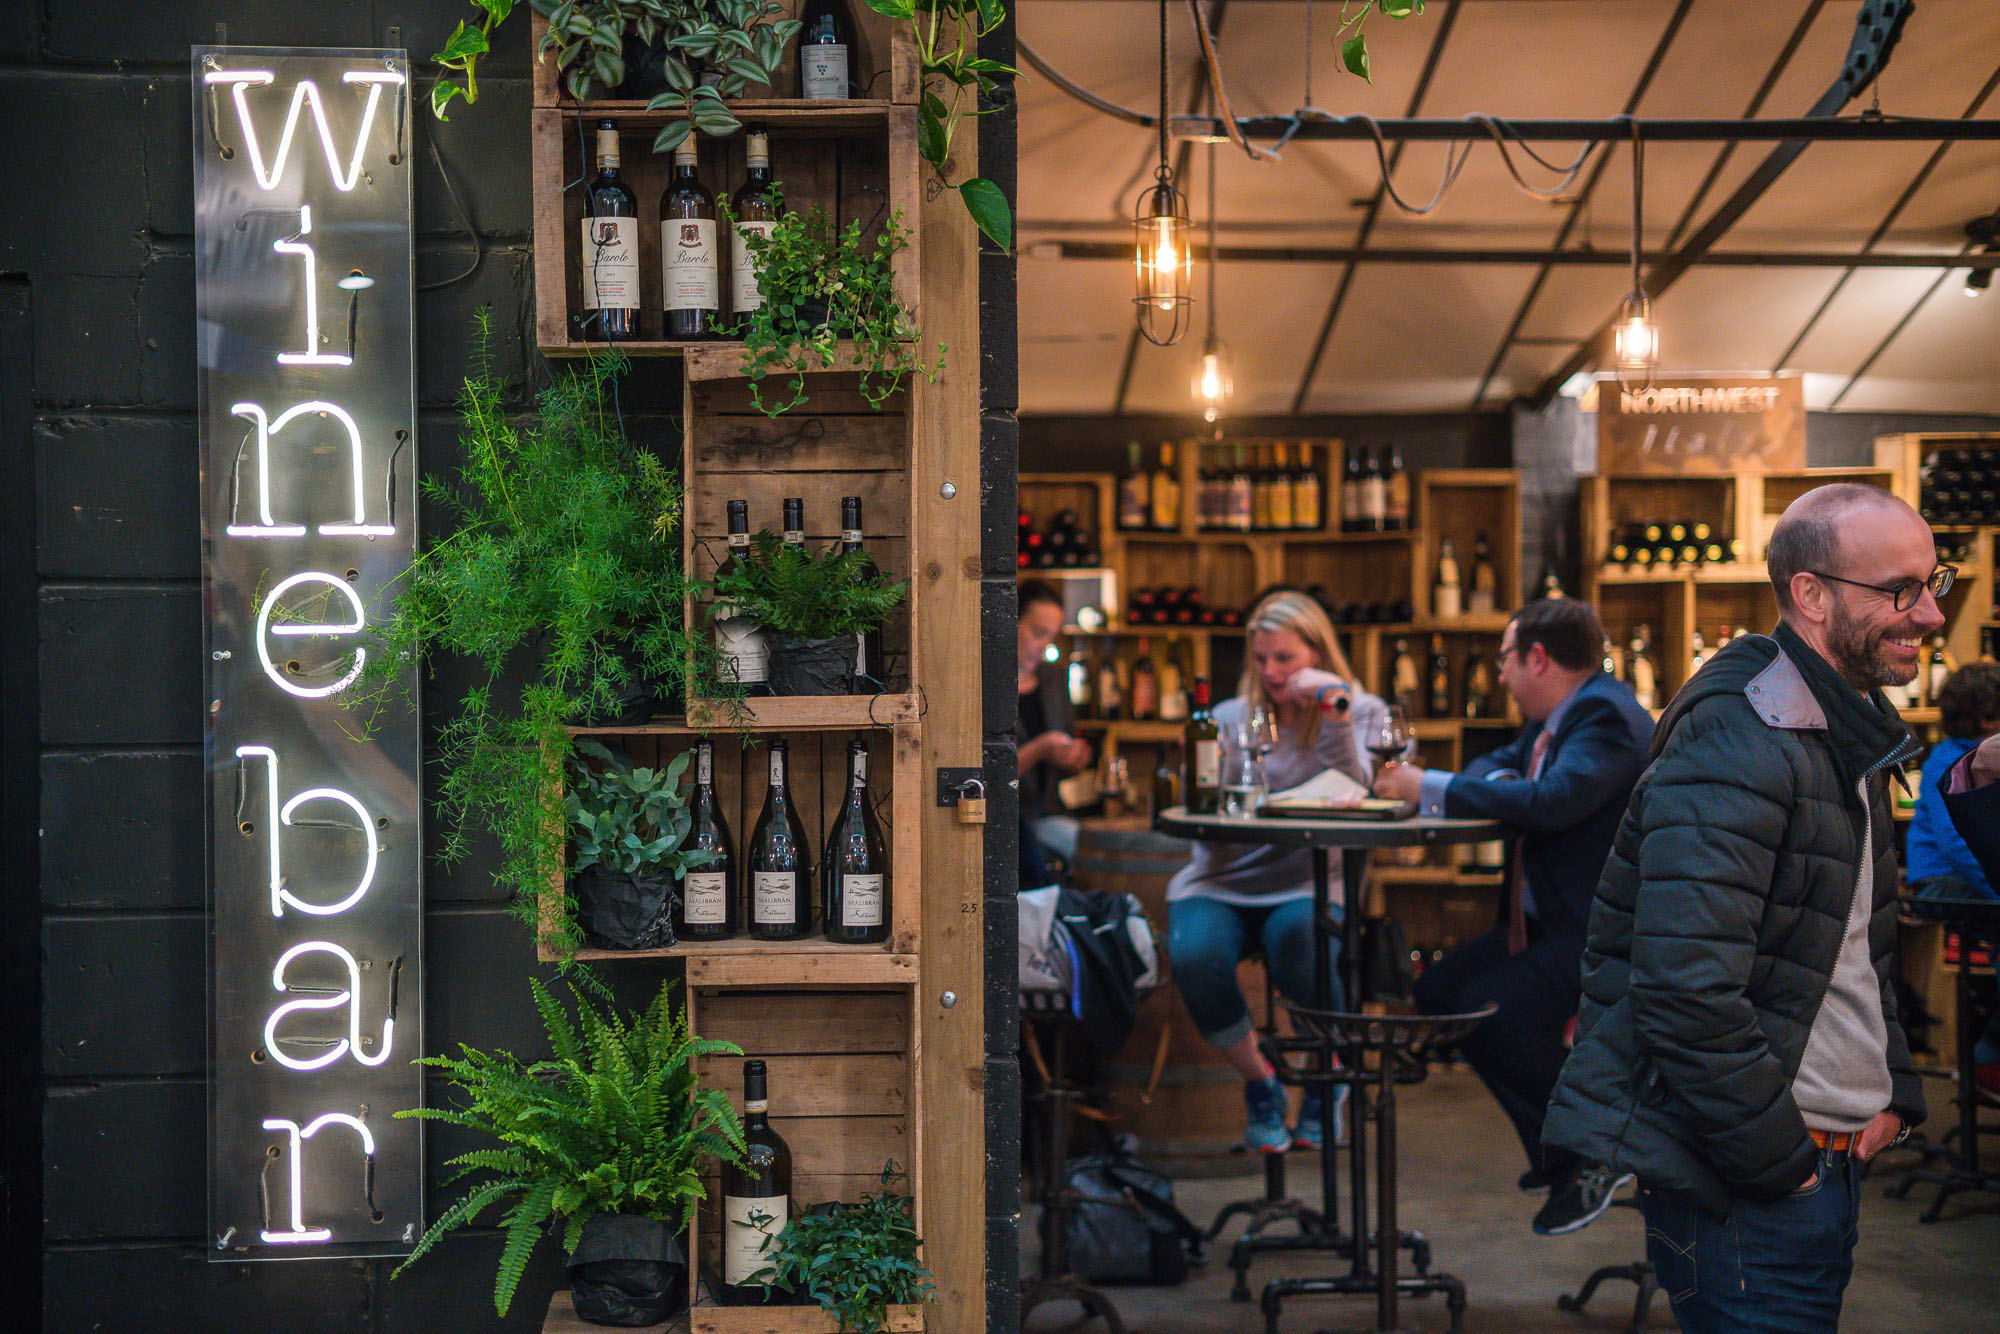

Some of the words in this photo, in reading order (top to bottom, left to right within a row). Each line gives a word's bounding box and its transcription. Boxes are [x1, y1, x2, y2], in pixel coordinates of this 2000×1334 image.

[592, 249, 629, 263] Barolo
[673, 250, 709, 264] Barolo
[1620, 386, 1780, 414] NORTHWEST
[205, 72, 405, 1243] winebar
[961, 903, 977, 914] 25
